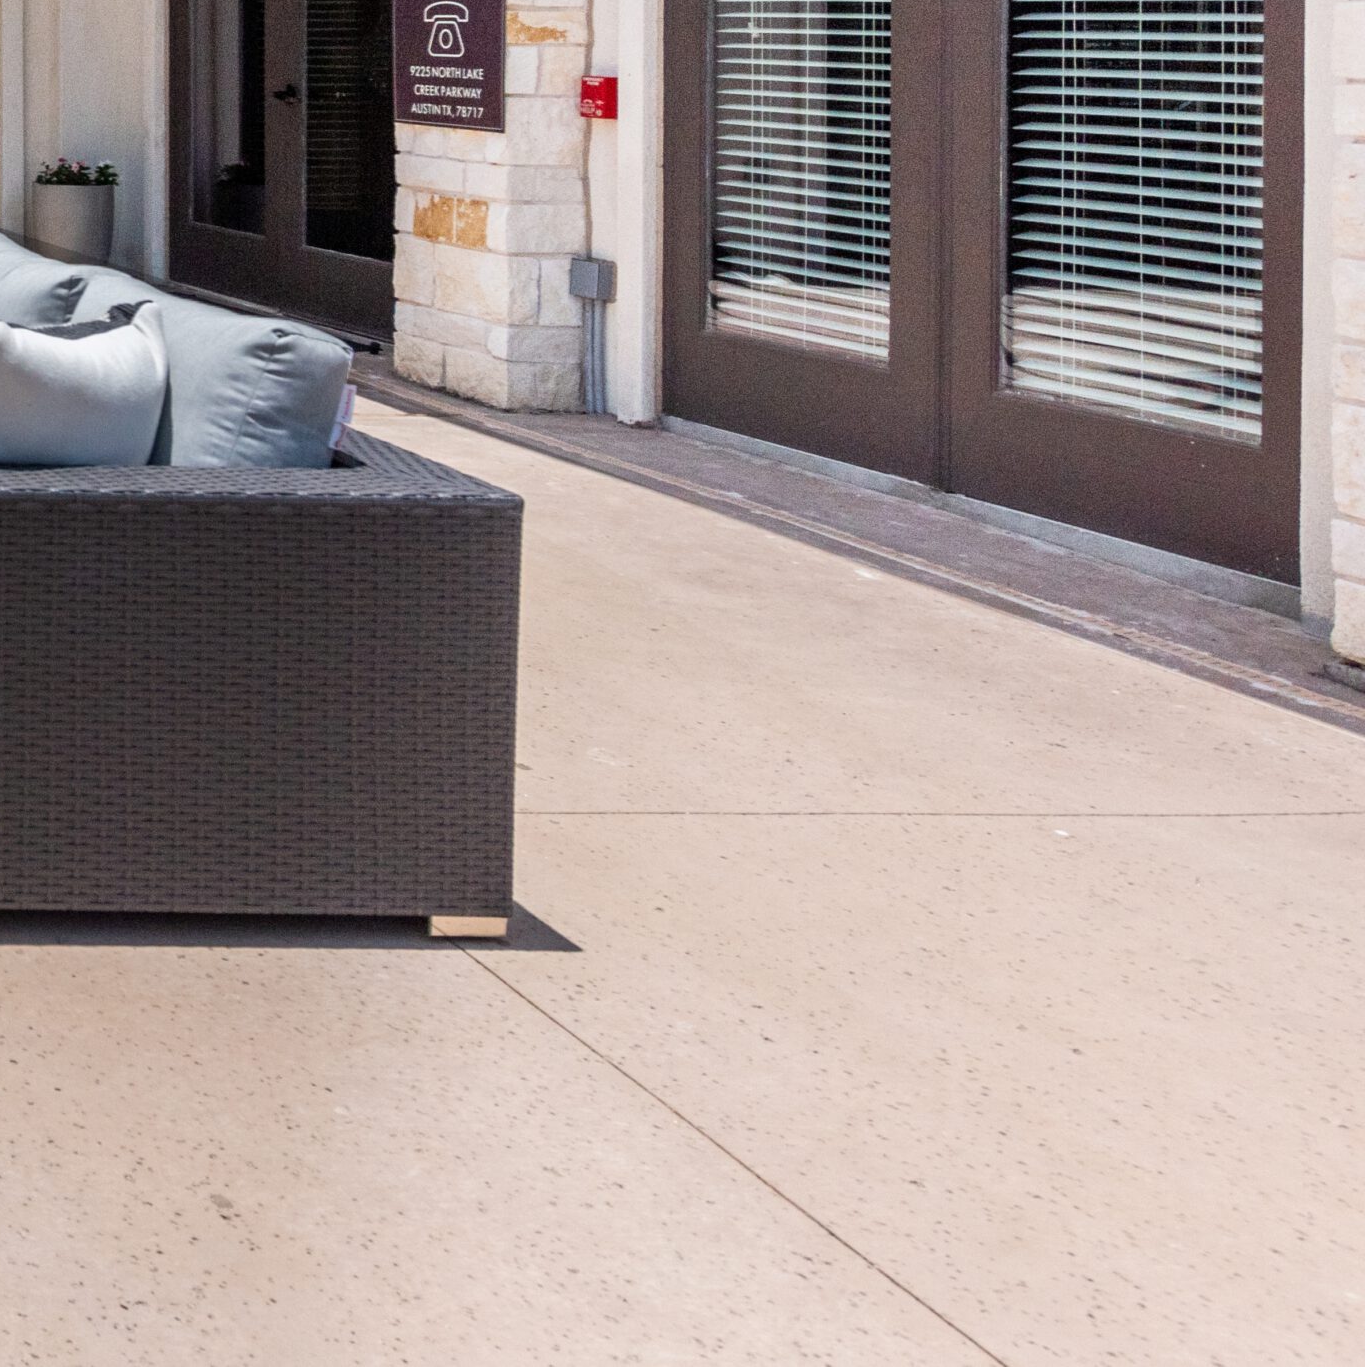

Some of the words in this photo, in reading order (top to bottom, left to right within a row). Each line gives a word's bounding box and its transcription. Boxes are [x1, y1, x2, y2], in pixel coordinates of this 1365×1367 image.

[410, 65, 431, 77] 9225
[431, 66, 462, 79] NORTH
[462, 68, 484, 80] LAKE
[414, 84, 440, 96] CREEK
[440, 85, 482, 99] PARKWAY
[411, 103, 441, 115] AUSTIN
[442, 104, 455, 118] TX,
[456, 105, 484, 118] 78717
